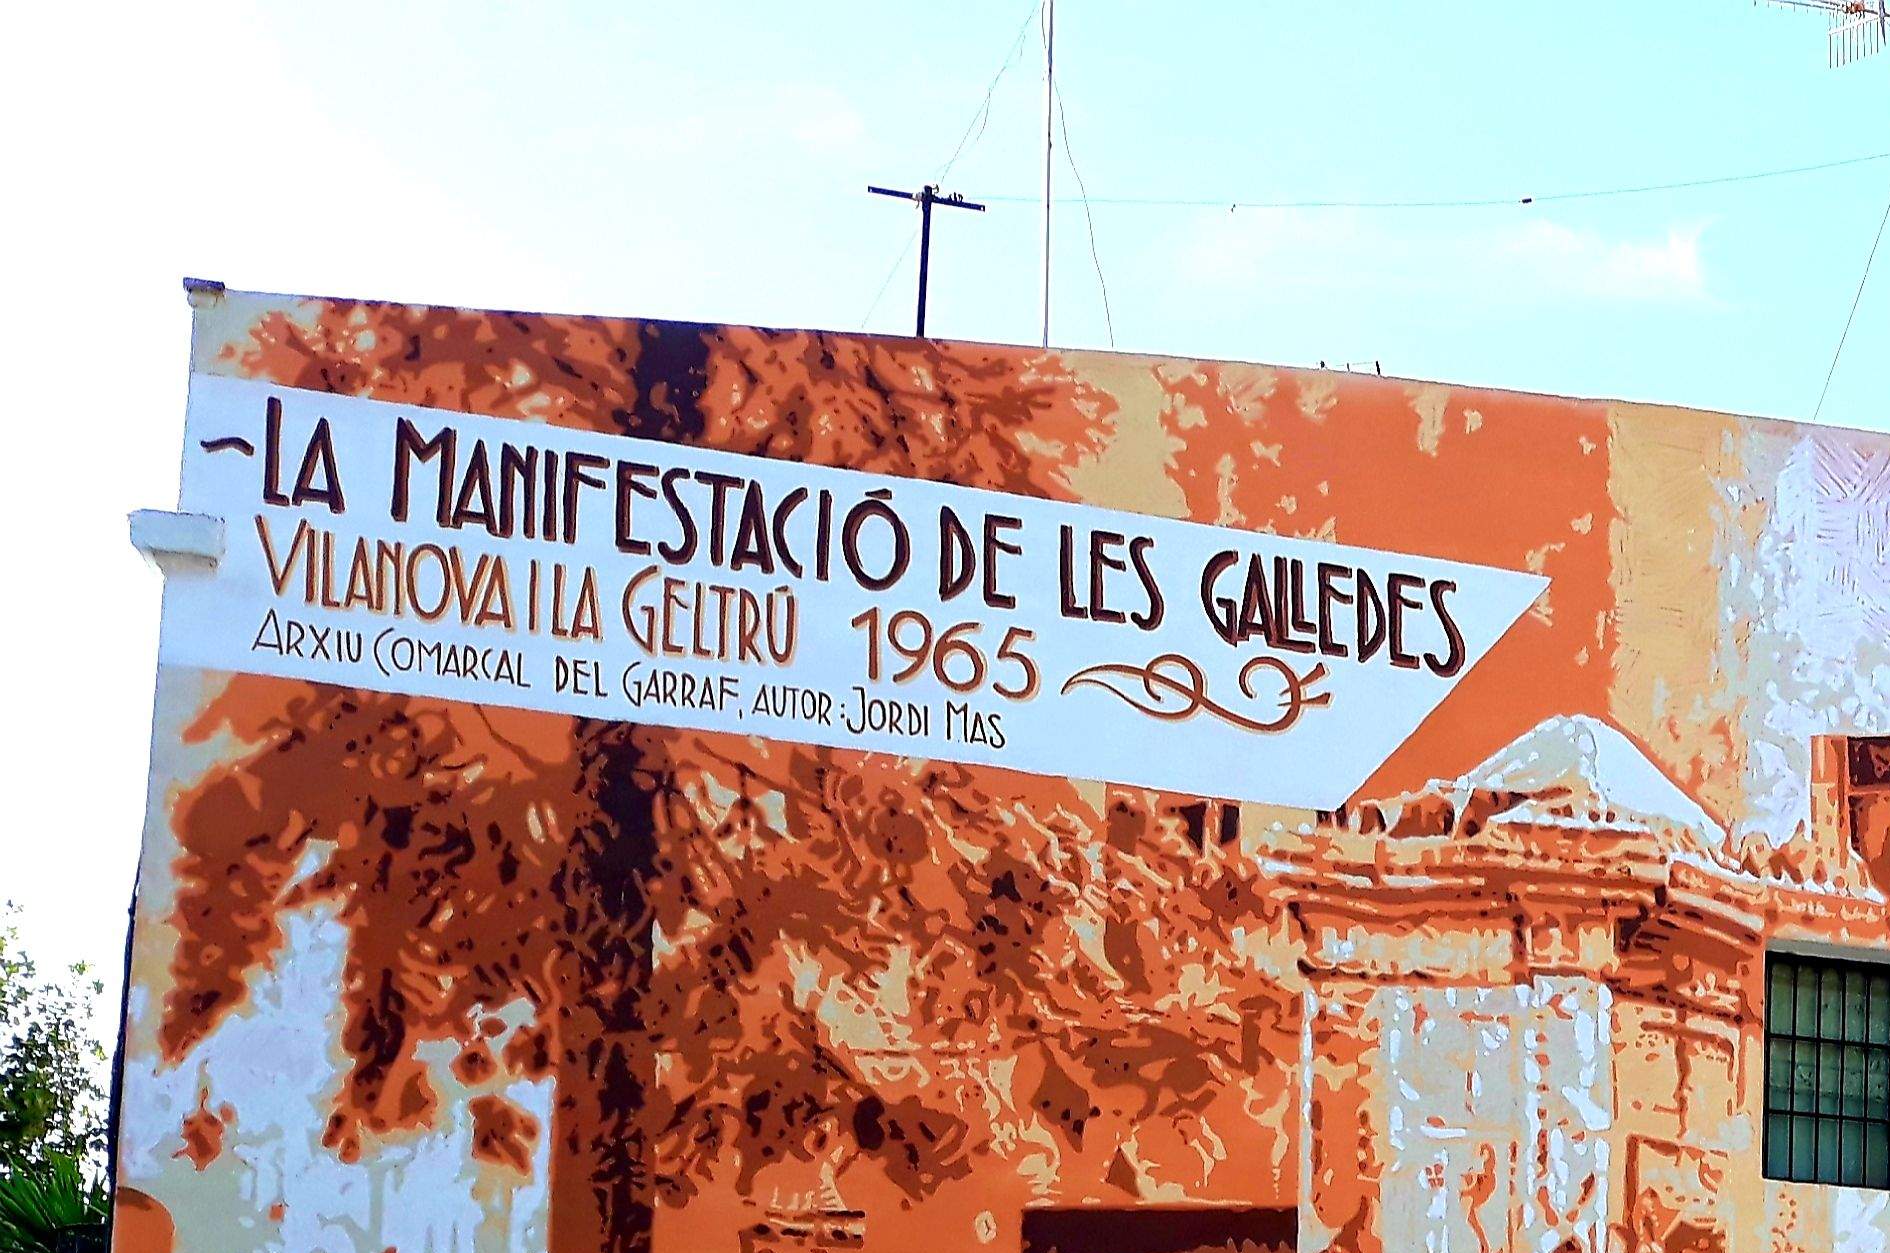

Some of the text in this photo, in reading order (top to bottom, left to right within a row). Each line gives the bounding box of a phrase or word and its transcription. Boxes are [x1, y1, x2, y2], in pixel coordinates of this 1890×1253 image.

[254, 514, 1041, 701] VILANOVA I LA GELTRÚ 1965
[263, 397, 1466, 678] LA MANIFESTACIÓ DE LES GALLEDES
[251, 608, 362, 663] ARXIU
[373, 627, 531, 689] COMARCAL
[554, 658, 608, 698] DEL
[621, 660, 744, 720] GARRAF,
[945, 701, 1007, 749] MAS
